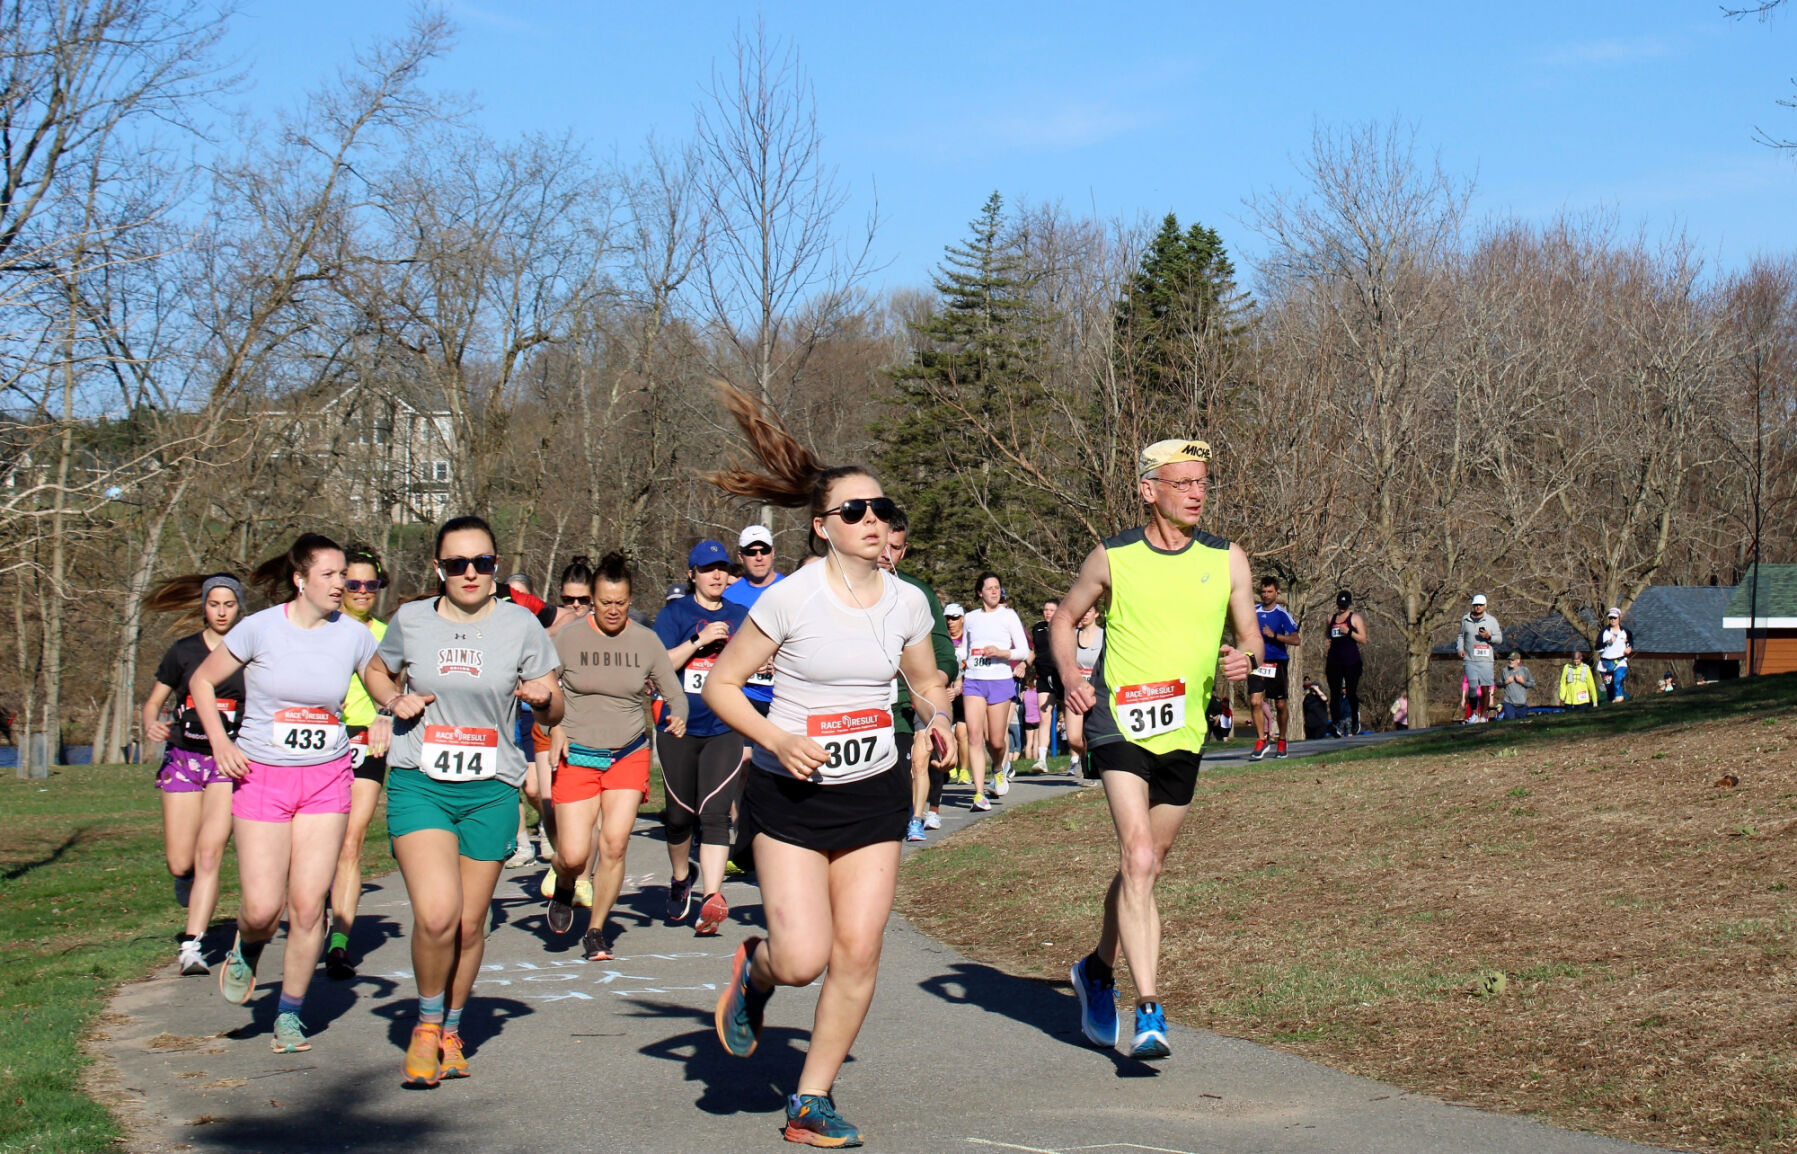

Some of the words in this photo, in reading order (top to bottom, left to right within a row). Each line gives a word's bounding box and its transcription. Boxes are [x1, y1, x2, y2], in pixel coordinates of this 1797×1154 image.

[439, 649, 482, 665] SAINTS
[580, 651, 640, 668] NOBULL
[1125, 690, 1143, 699] RACE
[1150, 685, 1175, 696] RESULT
[308, 712, 329, 720] RESULT
[820, 720, 842, 730] RACE
[851, 714, 878, 726] RESULT
[1129, 703, 1174, 733] 316
[284, 728, 327, 750] 433
[435, 731, 454, 740] RACE
[462, 733, 487, 742] RESULT
[824, 735, 878, 769] 307
[433, 750, 483, 775] 414
